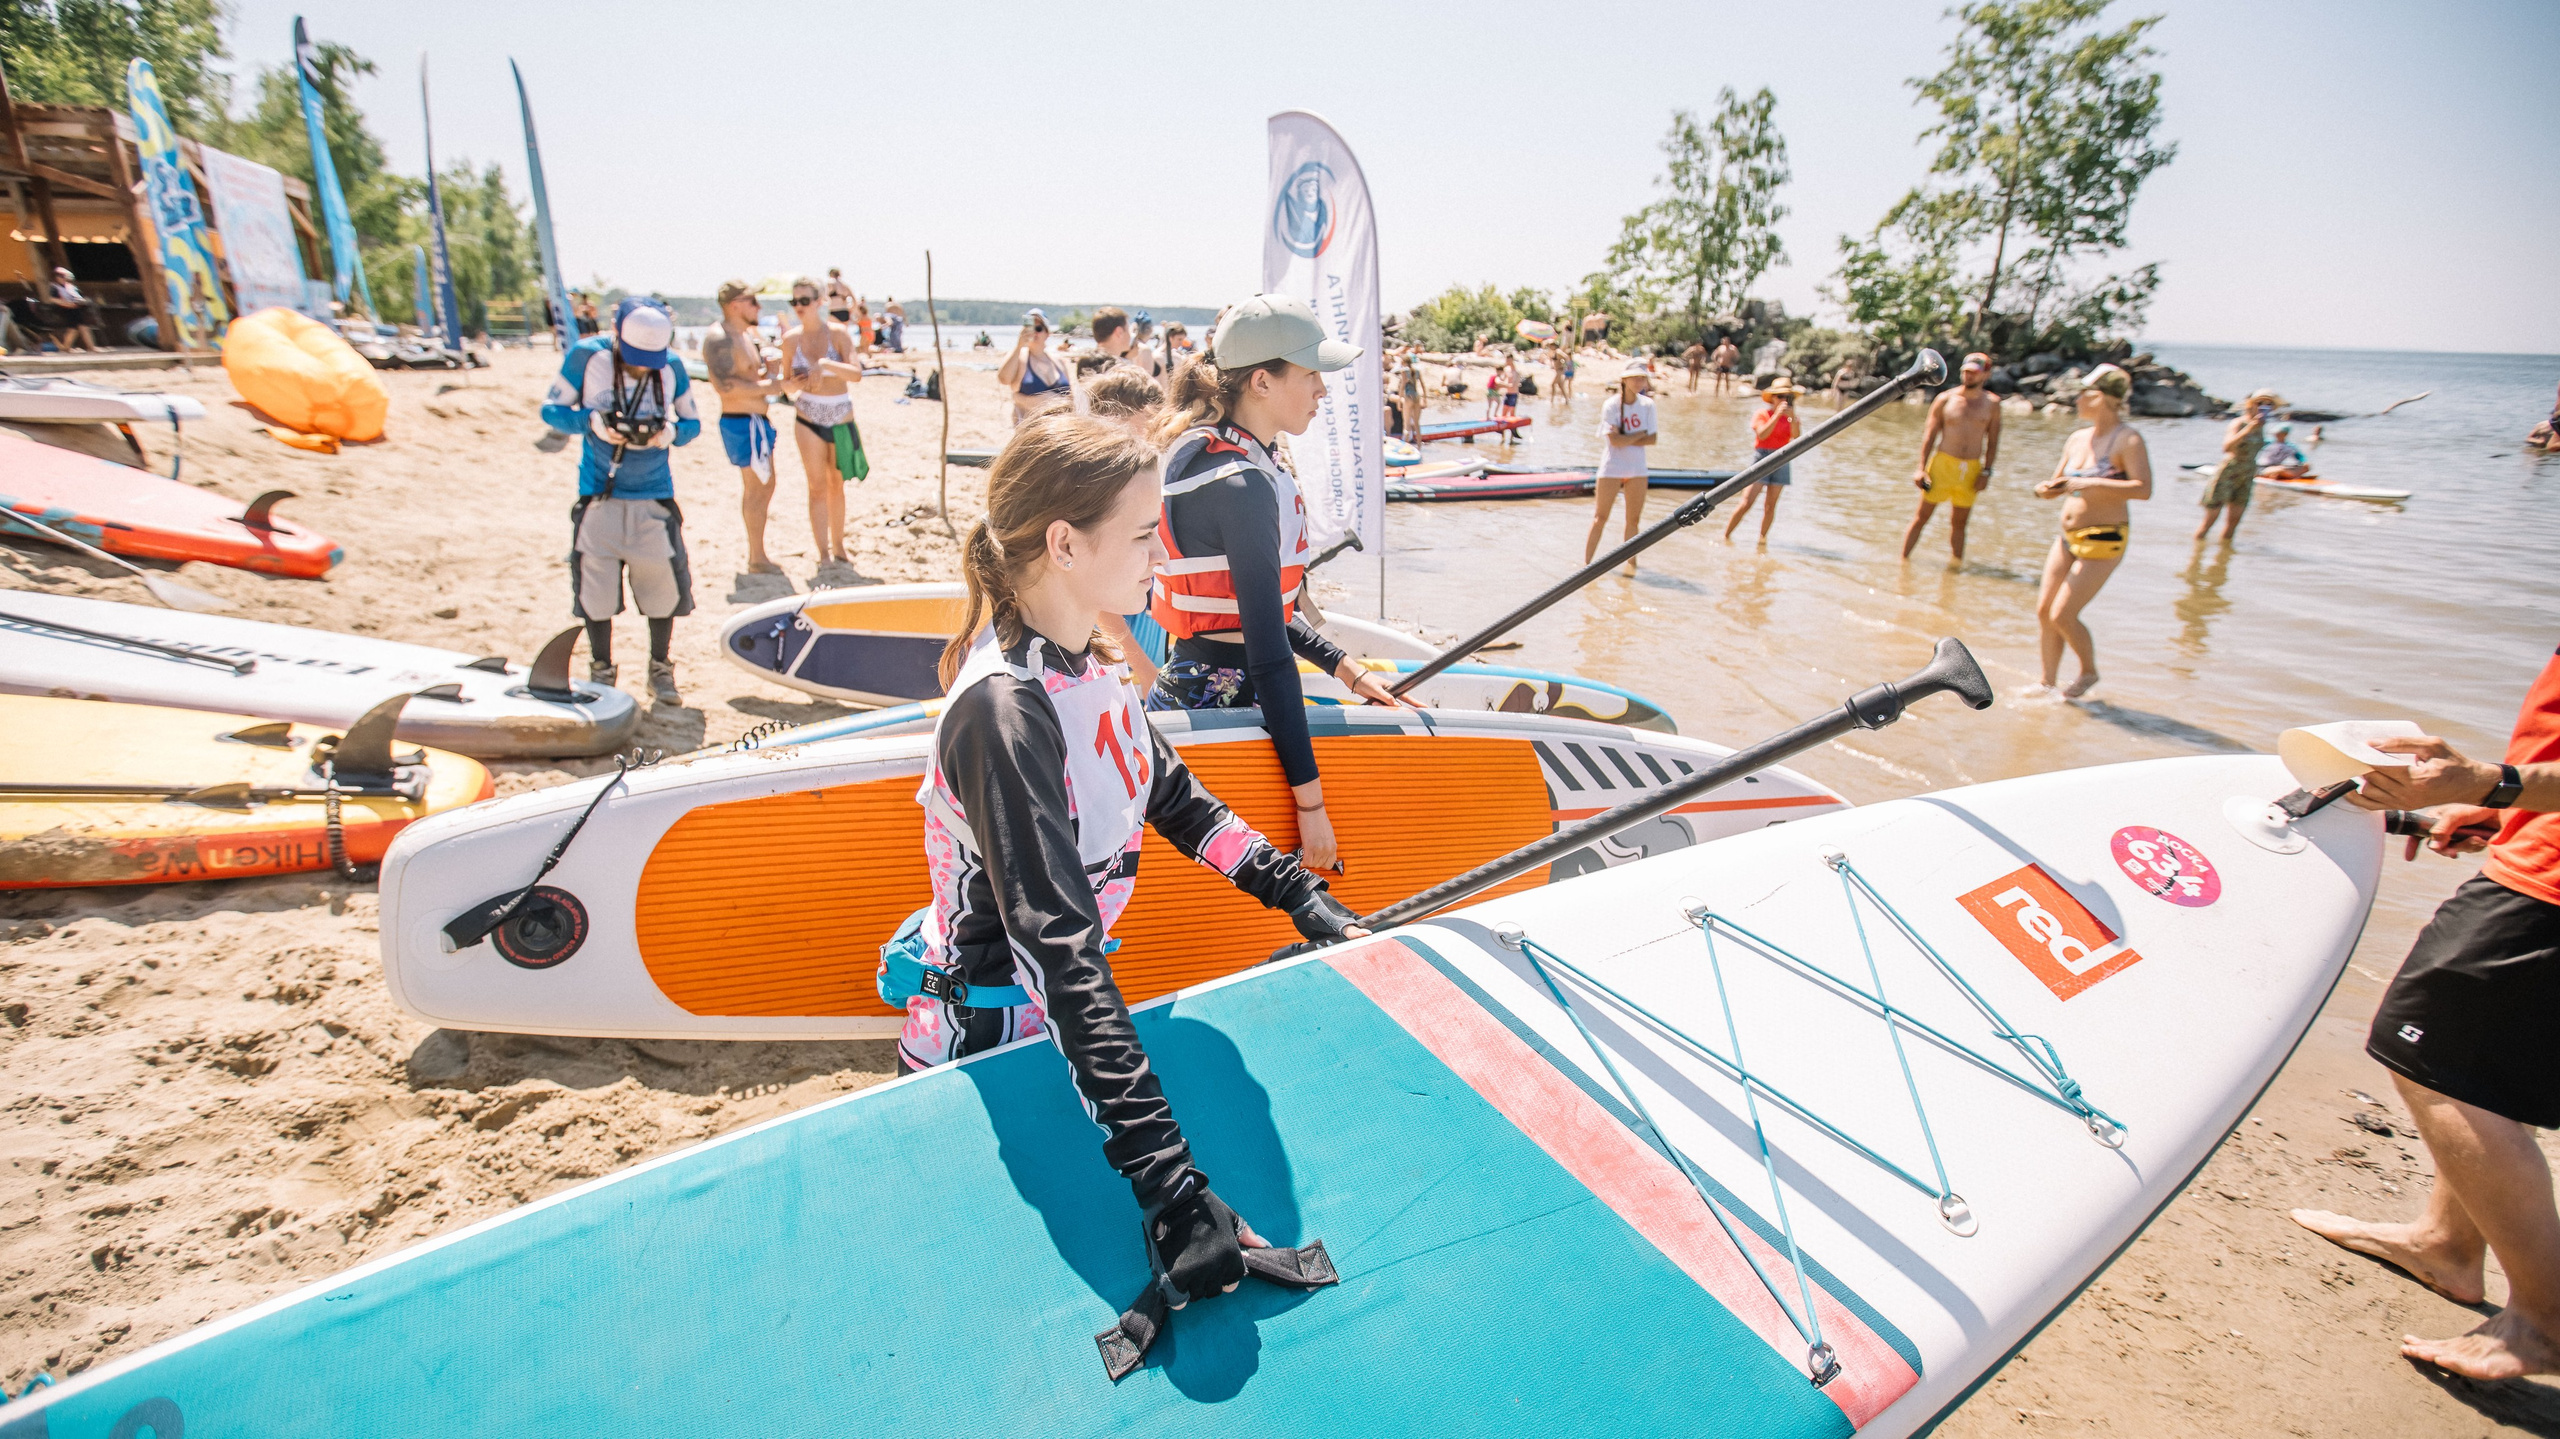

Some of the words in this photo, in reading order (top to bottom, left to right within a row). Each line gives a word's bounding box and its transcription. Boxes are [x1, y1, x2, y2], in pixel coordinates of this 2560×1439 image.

[1622, 413, 1642, 431] 16
[2127, 840, 2205, 897] 634
[2155, 834, 2210, 873] ДОСКА
[1991, 885, 2130, 977] red
